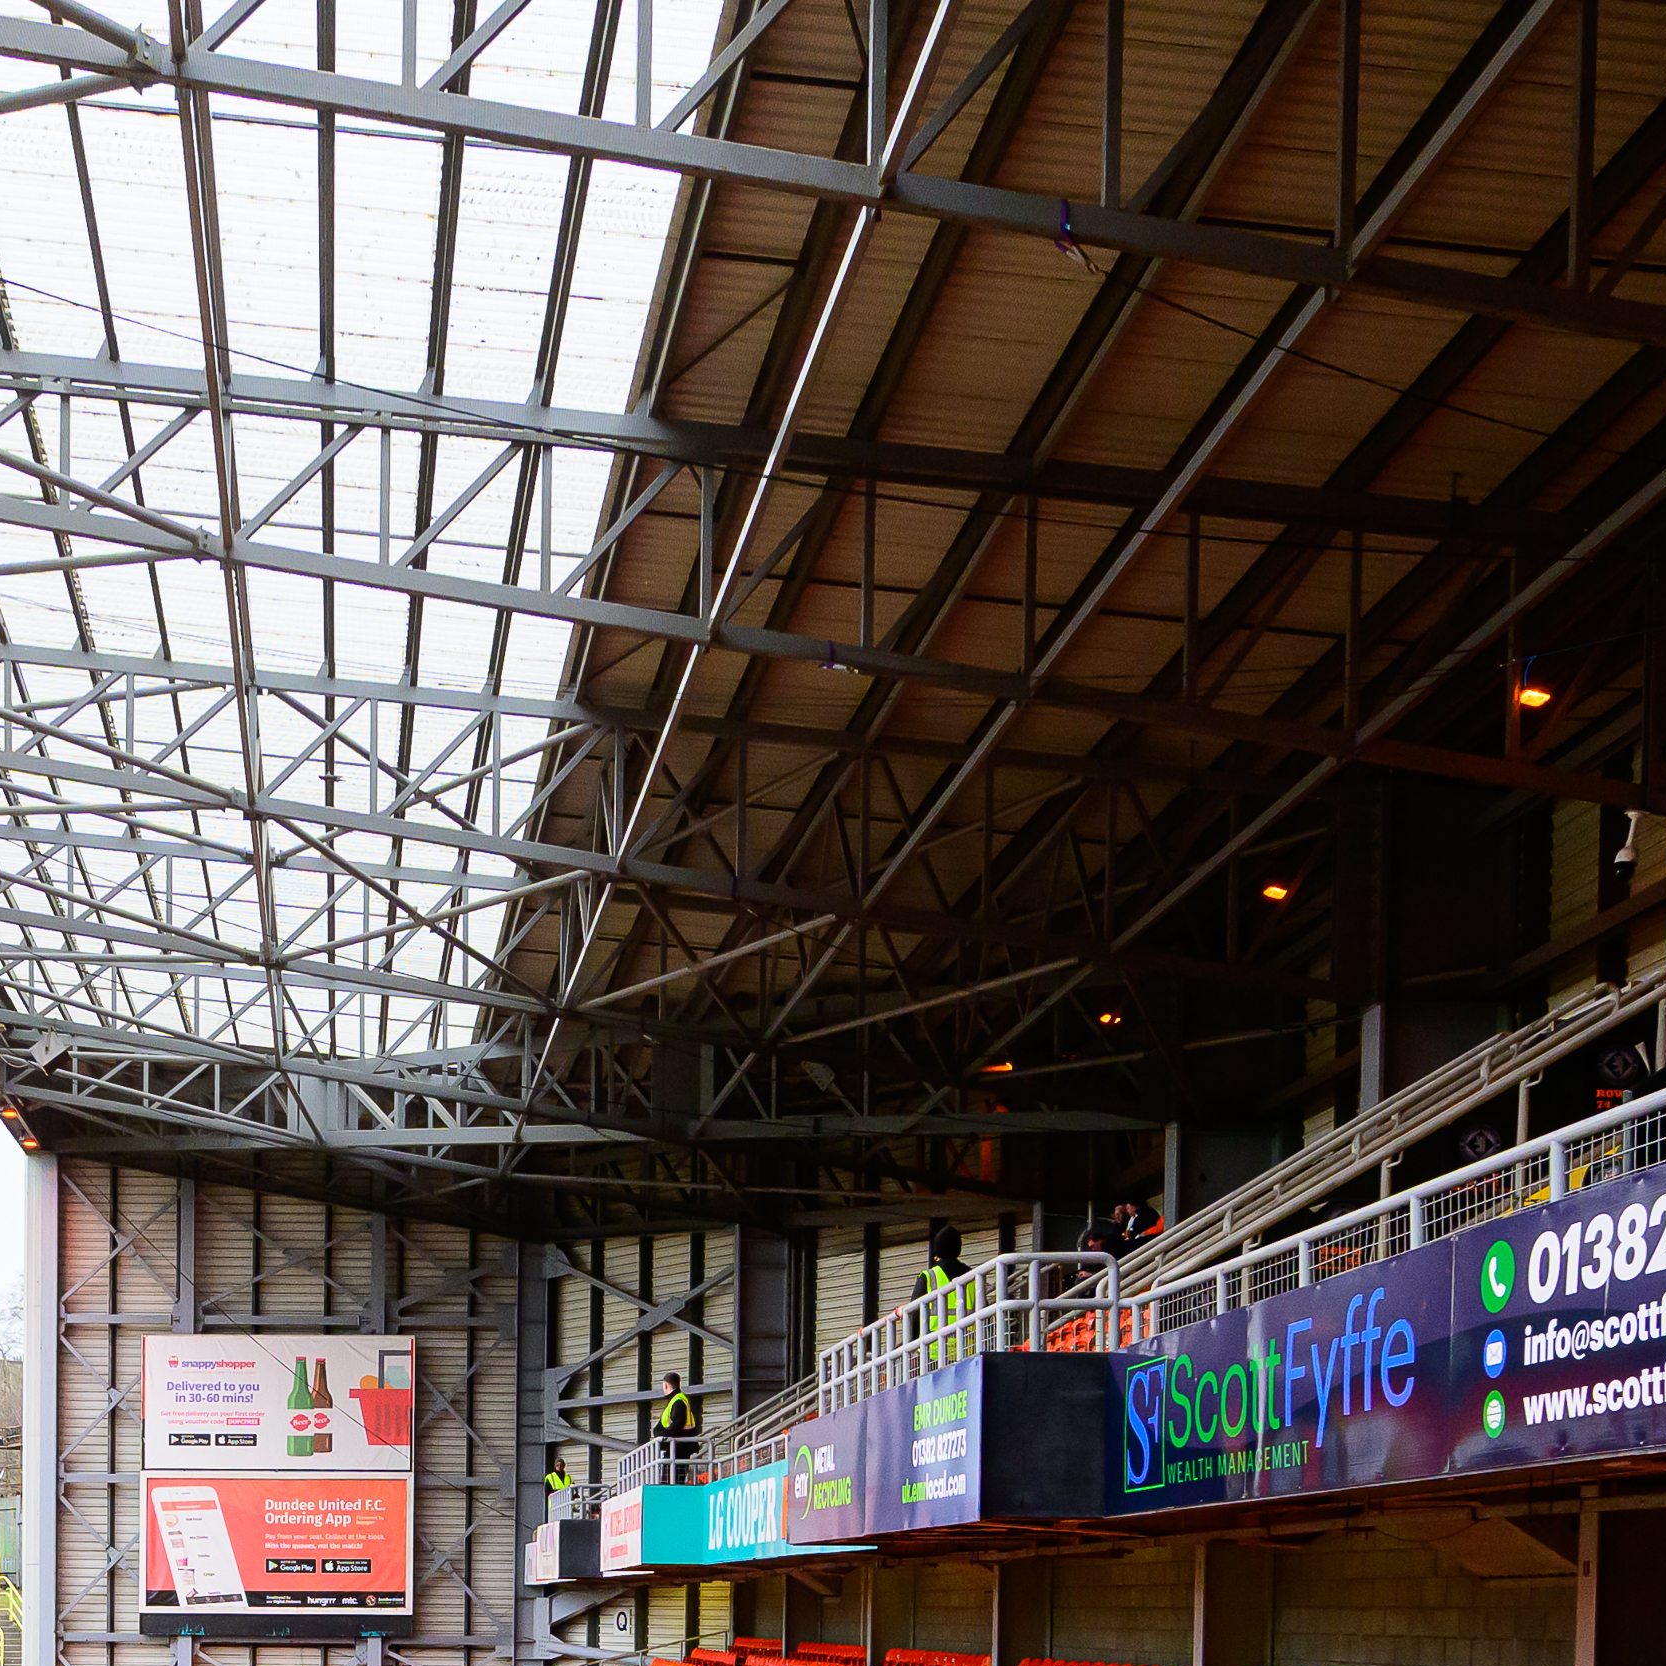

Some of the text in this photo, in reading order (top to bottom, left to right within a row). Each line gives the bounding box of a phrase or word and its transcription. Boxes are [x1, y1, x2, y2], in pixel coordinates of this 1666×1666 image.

[181, 1359, 257, 1370] snappyshopper
[1168, 1287, 1415, 1448] ScottFyffe
[166, 1381, 260, 1394] Delivered to you
[175, 1392, 254, 1403] in 30-60 mins!
[913, 1389, 968, 1432] EMR DUNDEE
[292, 1418, 310, 1427] Beer
[911, 1428, 967, 1468] 01382 827273
[813, 1444, 836, 1475] METAL
[1167, 1440, 1310, 1485] WEALTH MANAGEMENT
[813, 1476, 852, 1511] RECYCLING
[264, 1497, 386, 1511] Dundee United F.C.
[264, 1511, 351, 1527] Ordering App
[708, 1490, 725, 1550] LG
[726, 1476, 777, 1549] COOPER
[264, 1533, 276, 1541] Pay
[279, 1564, 314, 1572] Google Play
[336, 1565, 350, 1573] App
[616, 1611, 628, 1632] Q
